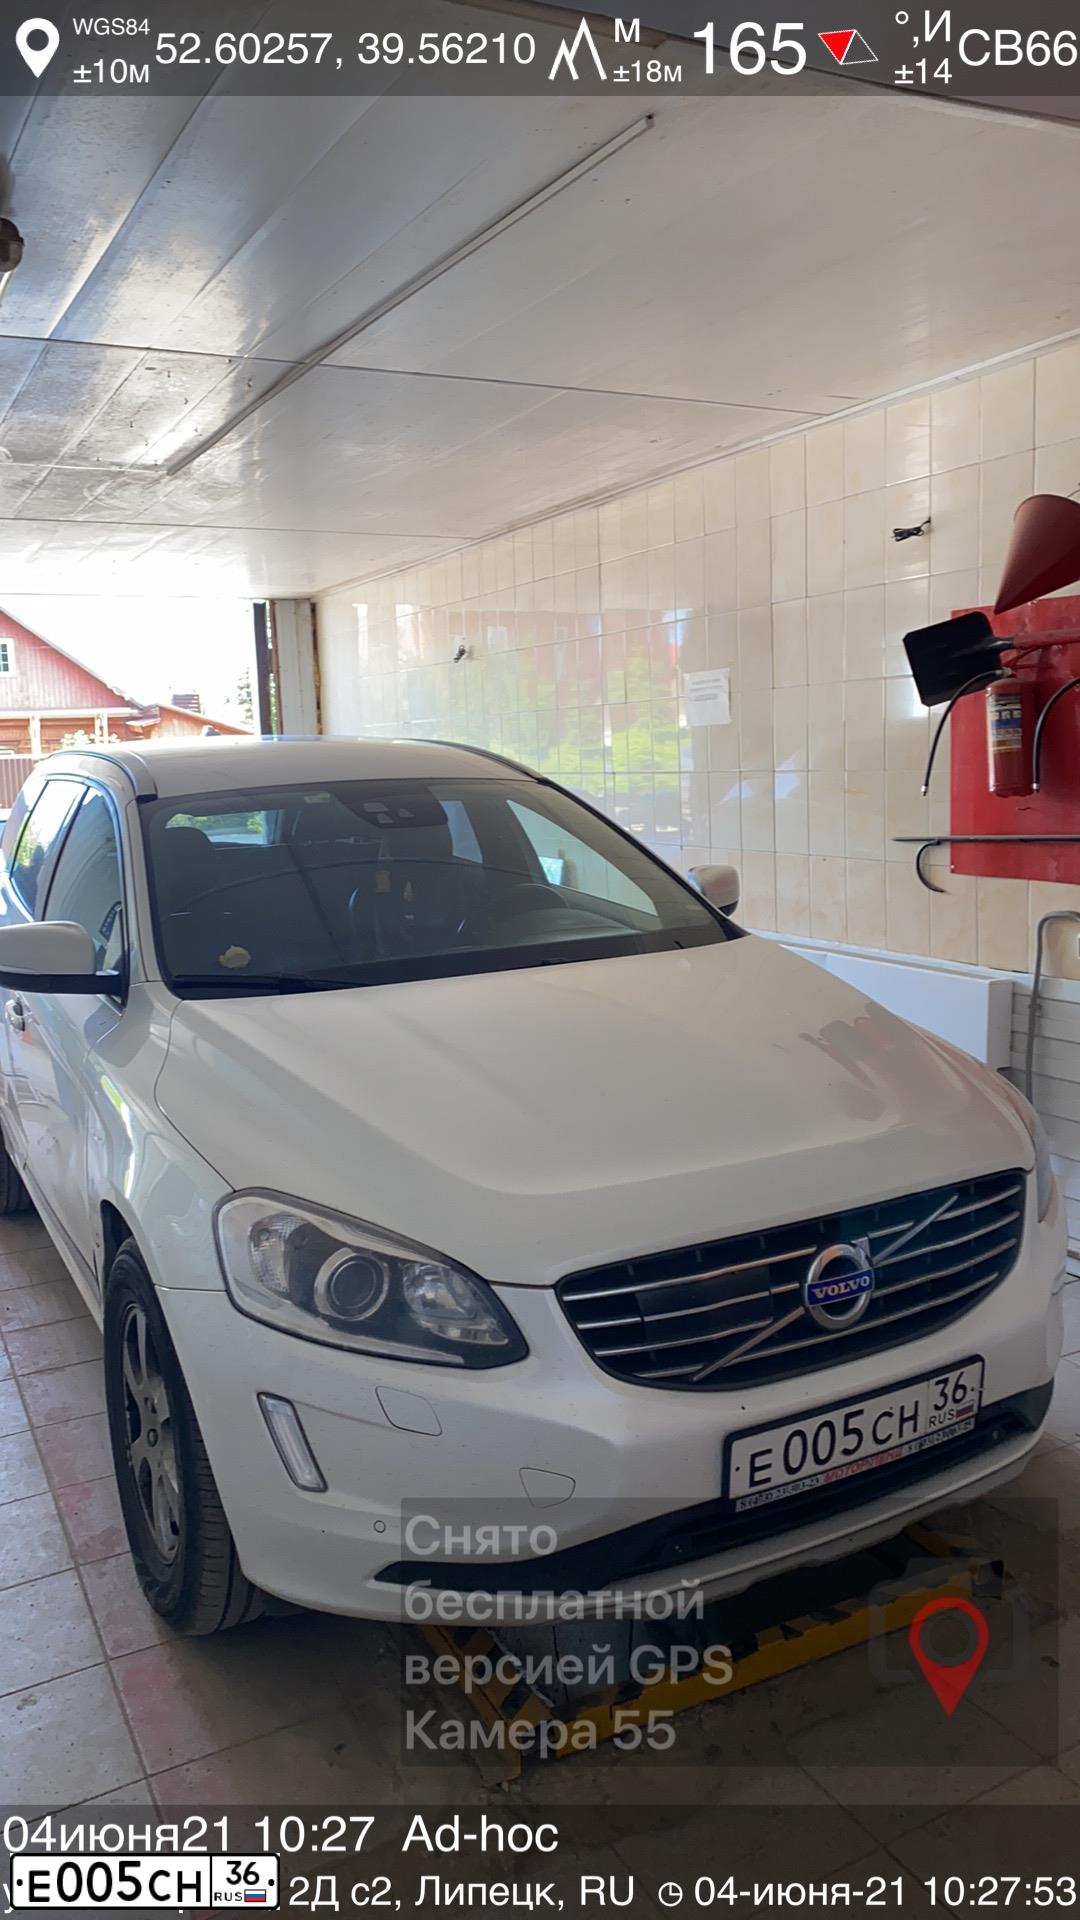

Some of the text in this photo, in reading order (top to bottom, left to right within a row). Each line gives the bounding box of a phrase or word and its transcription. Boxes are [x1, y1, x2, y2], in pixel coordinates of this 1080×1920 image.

[812, 1276, 870, 1299] VOLVO
[749, 1400, 920, 1489] Е005СН
[933, 1371, 968, 1411] 36
[928, 1408, 955, 1429] RUS
